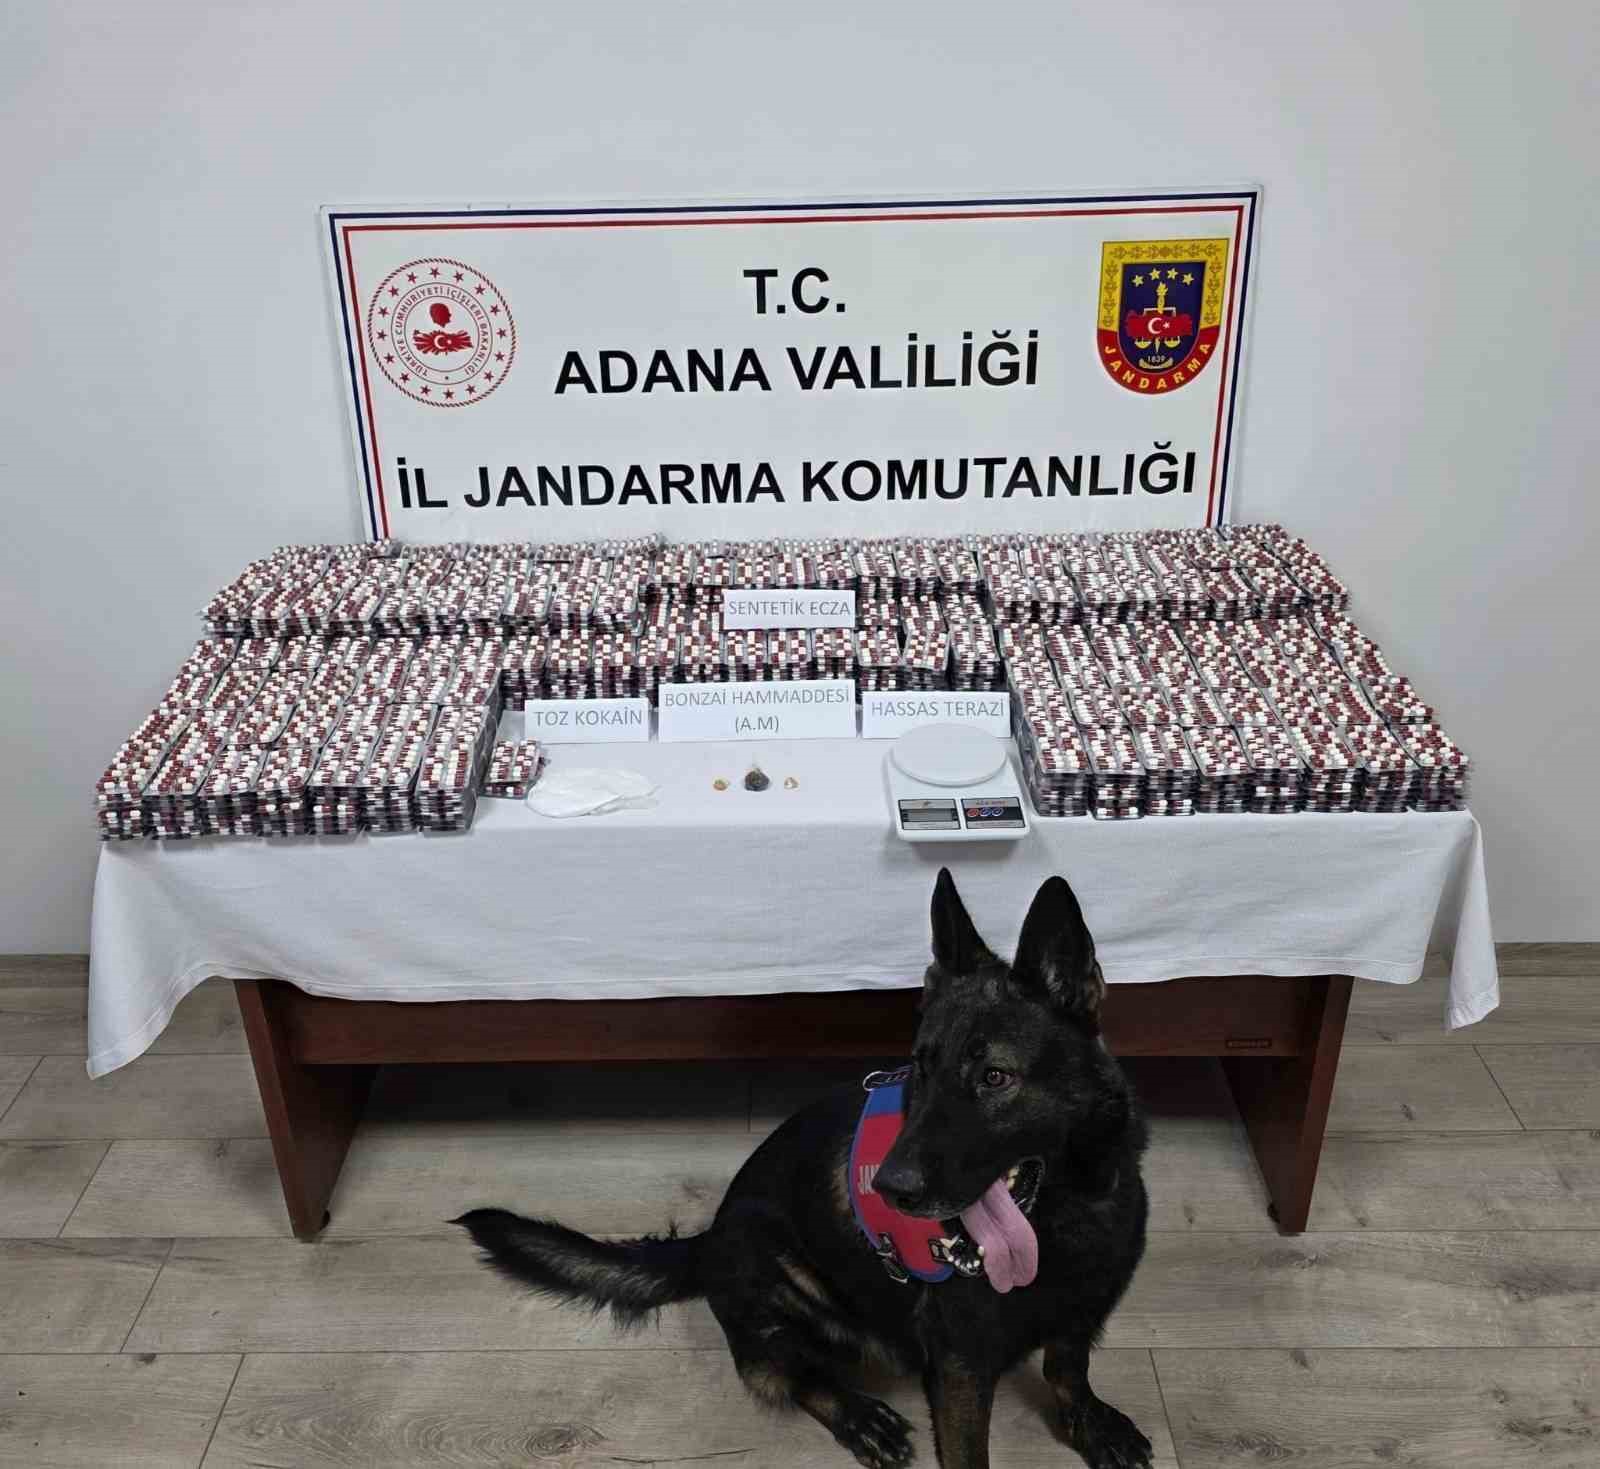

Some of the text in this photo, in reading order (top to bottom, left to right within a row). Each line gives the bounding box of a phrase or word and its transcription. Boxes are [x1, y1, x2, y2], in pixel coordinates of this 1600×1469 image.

[743, 267, 847, 315] T.C.
[554, 329, 1039, 395] ADANA VALİLİĞİ
[1104, 343, 1211, 390] JANDARMA
[396, 440, 1196, 509] İL JANDARMA KOMUTANLIĞI
[728, 598, 851, 617] SENTETİK ECZA
[664, 684, 849, 707] BONZAİ HAMMADDESİ
[535, 706, 643, 726] TOZ KOKAİN
[871, 698, 1005, 718] HASSAS TERAZİ
[735, 715, 780, 734] (A.M)
